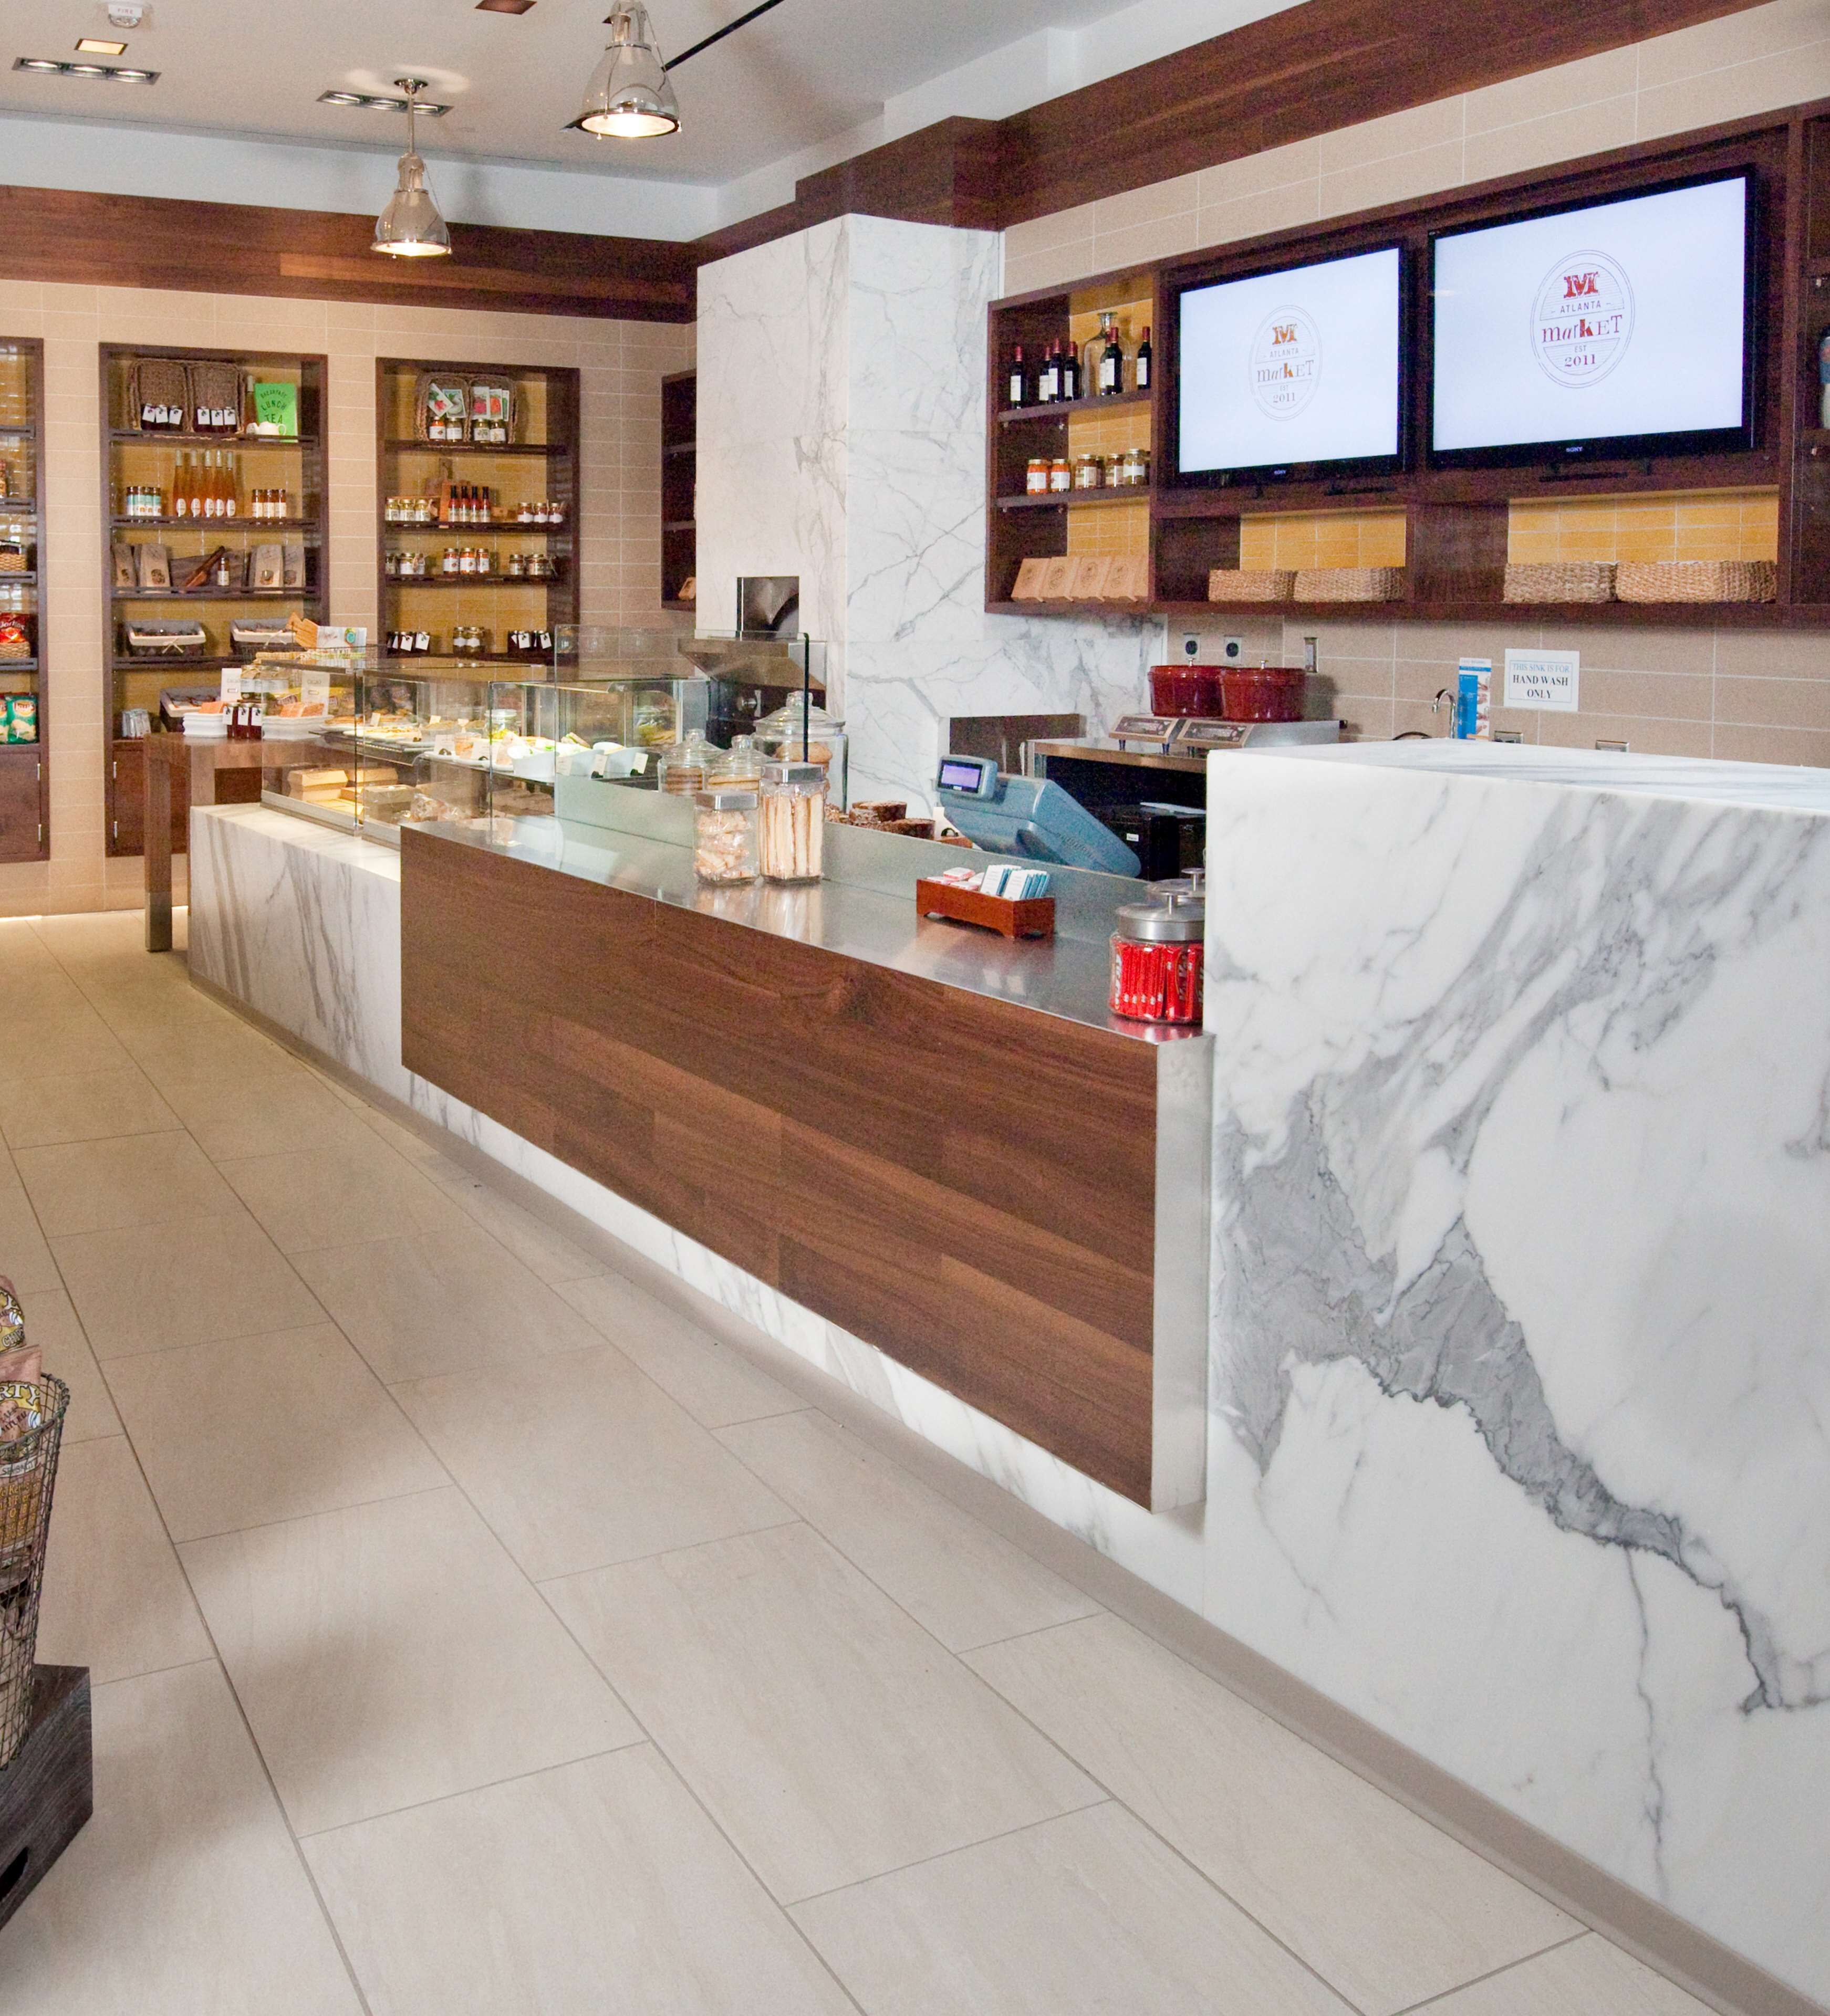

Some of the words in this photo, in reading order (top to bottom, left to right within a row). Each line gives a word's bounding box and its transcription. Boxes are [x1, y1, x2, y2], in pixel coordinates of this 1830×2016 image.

[1564, 271, 1599, 298] M
[1560, 300, 1601, 314] ATLANTA
[1272, 323, 1298, 345] M
[1270, 348, 1299, 358] ATLANTA
[1565, 354, 1595, 367] 2011
[1273, 392, 1295, 403] 2011
[261, 400, 287, 411] LUNCH
[264, 414, 283, 424] TEA
[1529, 663, 1545, 672] SINK
[1513, 674, 1538, 684] HAND
[1541, 675, 1568, 686] WASH
[1526, 688, 1553, 698] ONLY
